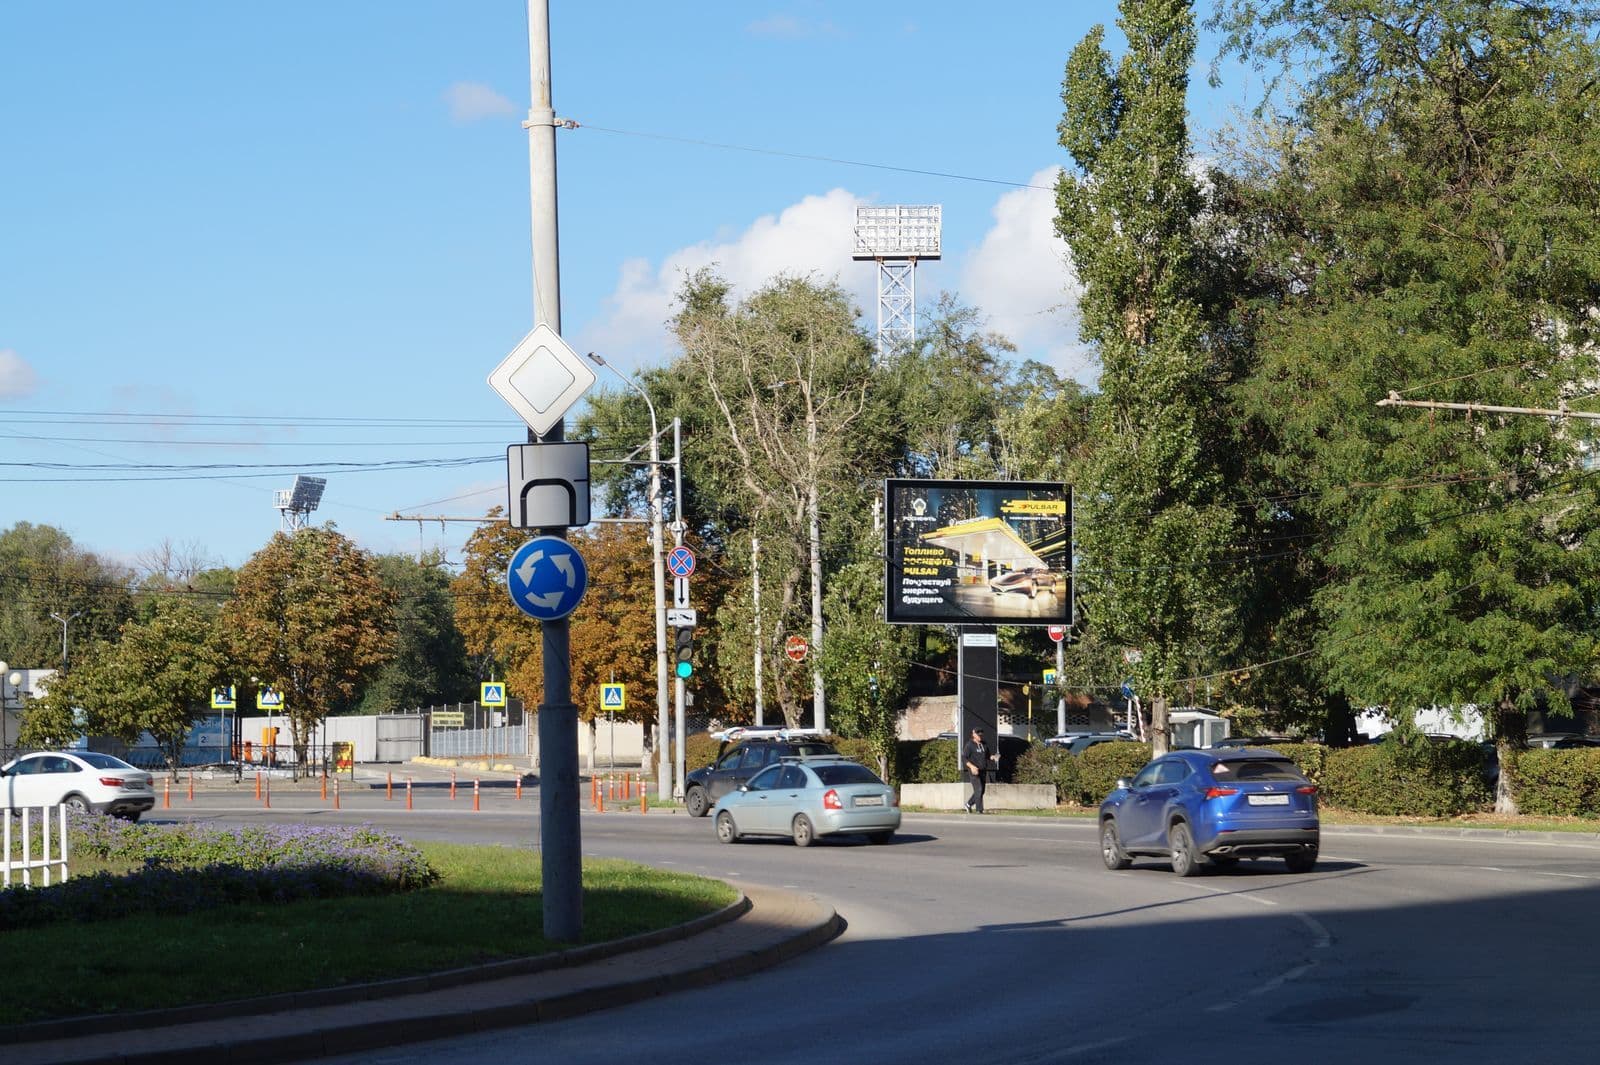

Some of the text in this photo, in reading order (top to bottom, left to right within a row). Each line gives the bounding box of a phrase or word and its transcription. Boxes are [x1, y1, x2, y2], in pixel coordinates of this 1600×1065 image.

[903, 546, 945, 556] Топливо
[903, 557, 954, 566] РОСНЕФТЬ
[903, 567, 939, 576] PULSAR
[902, 578, 952, 587] Почувствуй
[902, 596, 944, 605] будущего
